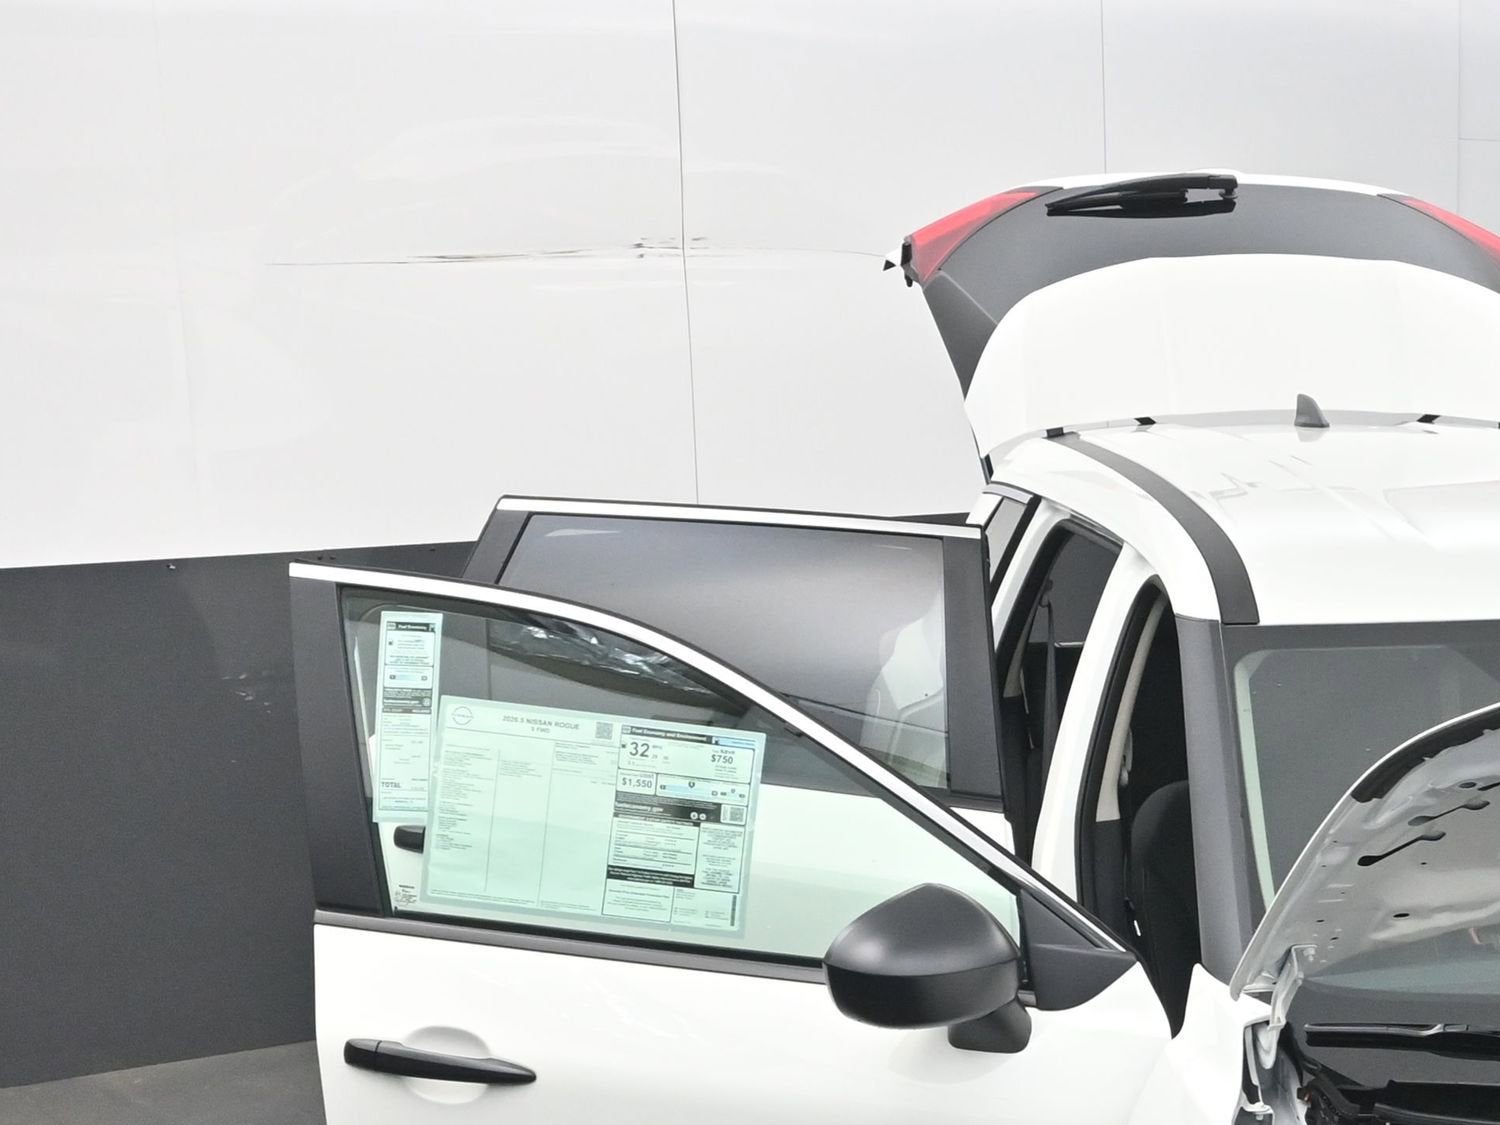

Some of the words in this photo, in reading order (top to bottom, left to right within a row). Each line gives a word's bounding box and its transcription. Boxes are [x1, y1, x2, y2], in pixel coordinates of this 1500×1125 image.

[526, 718, 553, 727] NISSAN
[554, 721, 580, 730] ROGUE
[629, 741, 650, 758] 32
[711, 753, 734, 765] $750
[622, 777, 653, 789] $1,550
